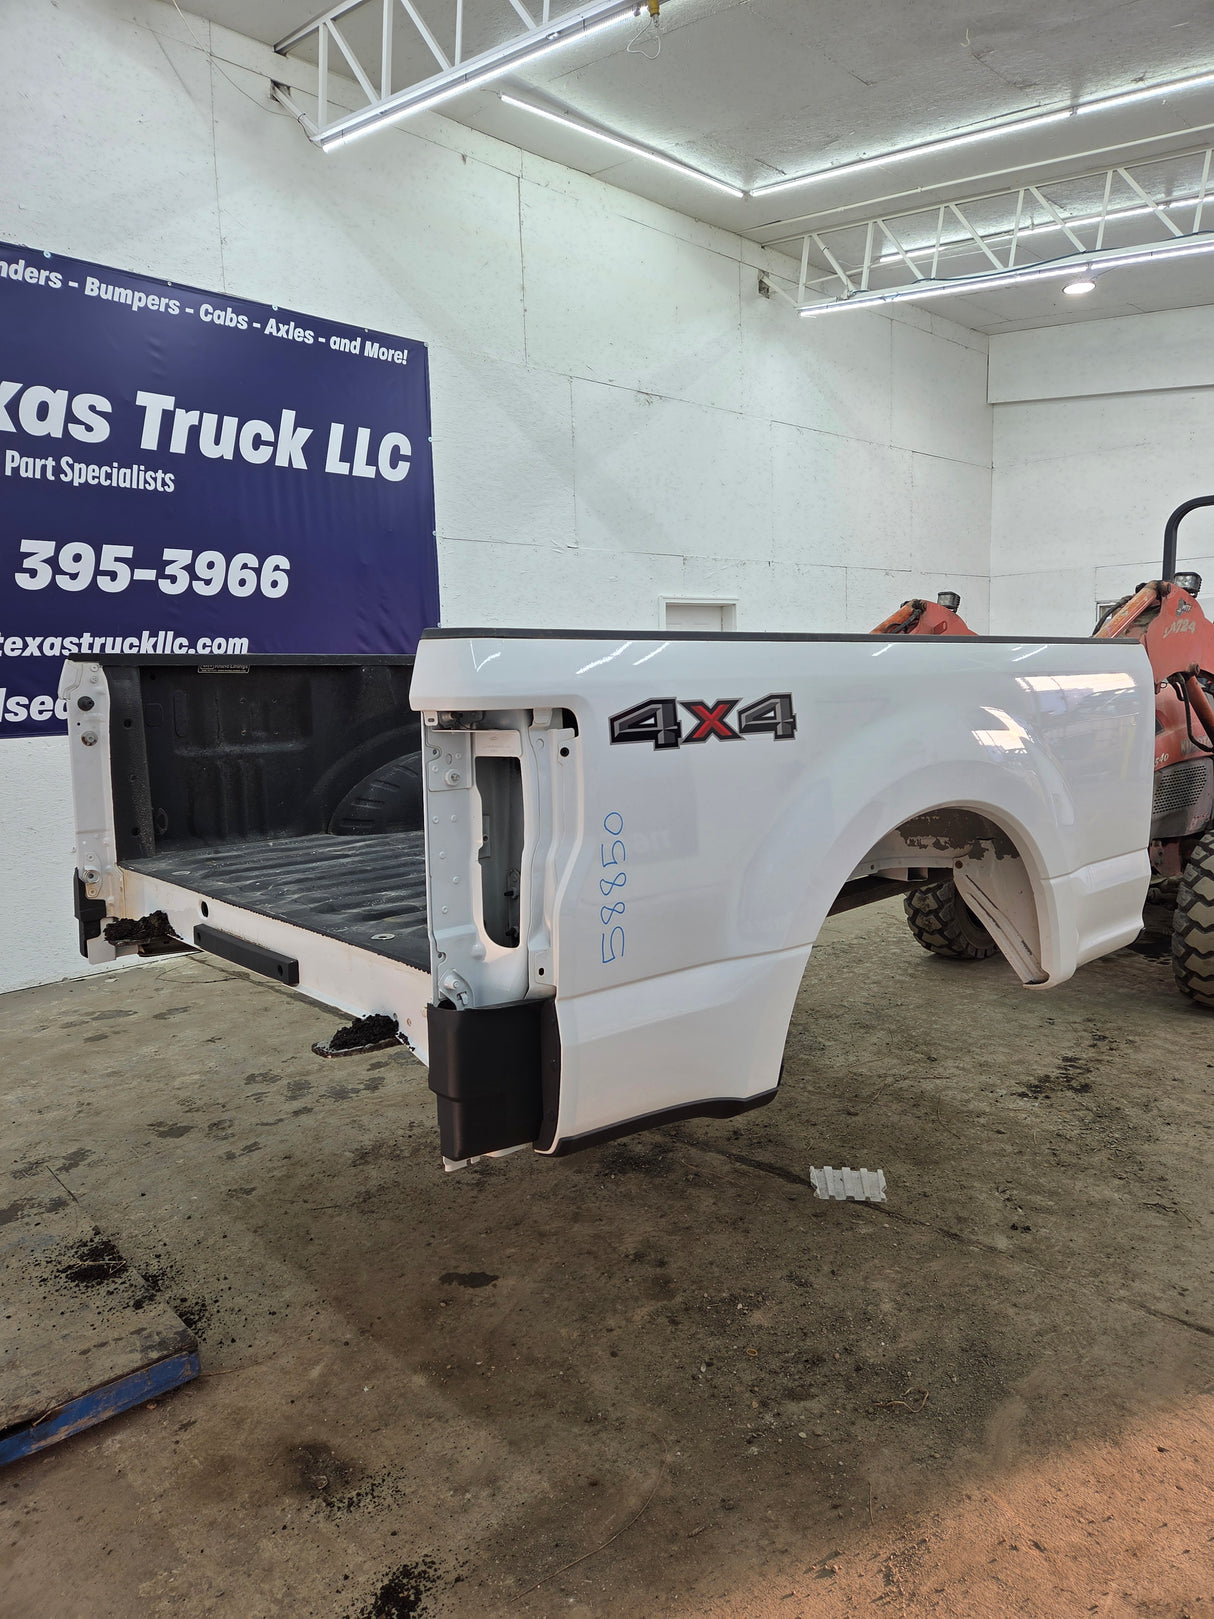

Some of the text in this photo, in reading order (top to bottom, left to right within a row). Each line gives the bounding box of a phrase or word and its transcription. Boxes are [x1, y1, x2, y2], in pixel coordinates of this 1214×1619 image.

[84, 276, 180, 315] Bumpers
[199, 303, 249, 330] Cabs
[263, 318, 315, 345] Axles
[329, 335, 362, 355] and
[363, 340, 408, 365] More!
[5, 449, 175, 493] Part Specialists
[136, 390, 313, 470] Truck
[324, 422, 412, 482] LLC
[14, 539, 291, 599] 395-3966
[600, 812, 627, 963] 58850
